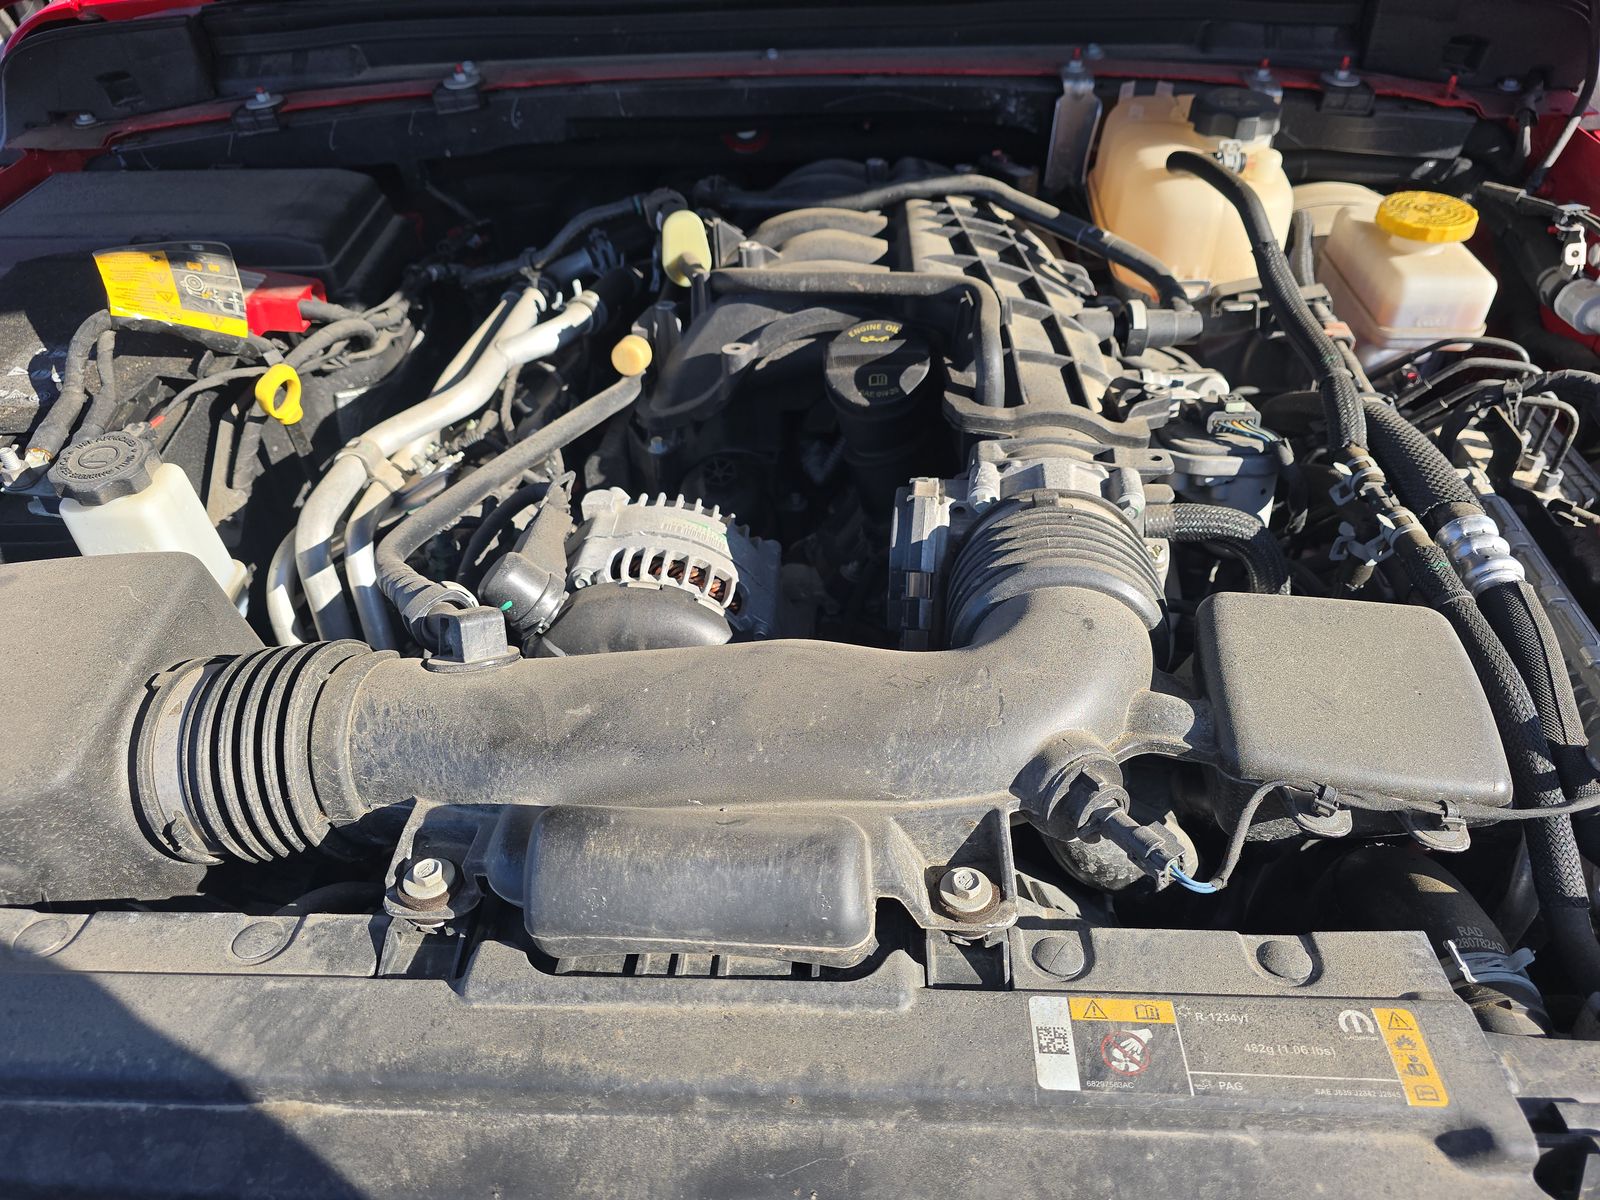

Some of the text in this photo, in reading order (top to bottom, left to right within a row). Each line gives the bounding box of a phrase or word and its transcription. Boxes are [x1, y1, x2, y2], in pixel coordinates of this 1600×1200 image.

[847, 323, 900, 338] ENGINE OIL
[1456, 926, 1484, 937] RAD
[1442, 937, 1505, 954] 6280782AD
[1195, 1012, 1250, 1025] R-1234yf
[1243, 1043, 1337, 1058] 482g (1.06 lbs)
[1218, 1081, 1244, 1091] PAG
[1314, 1088, 1332, 1096] SAE
